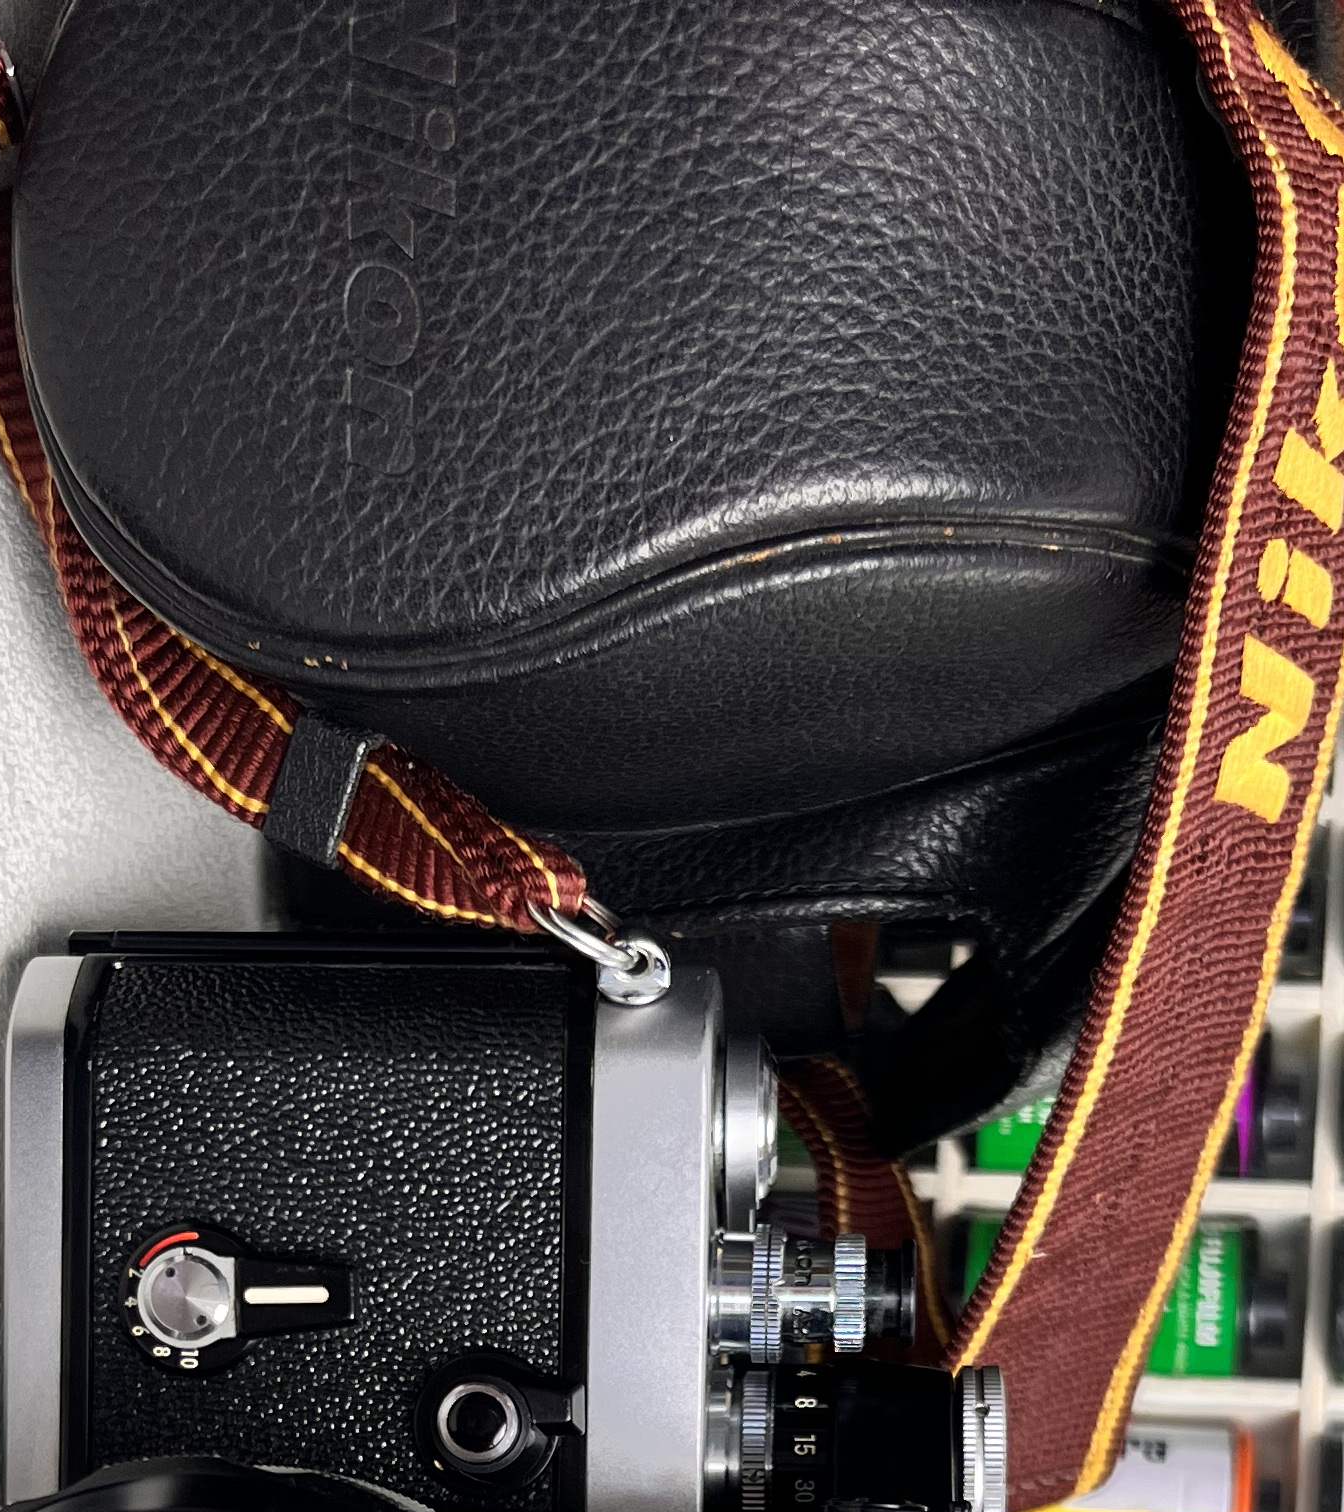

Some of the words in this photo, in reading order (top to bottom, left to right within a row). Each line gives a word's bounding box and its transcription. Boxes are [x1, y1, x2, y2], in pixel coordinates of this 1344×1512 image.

[128, 1267, 143, 1279] 2
[124, 1296, 139, 1309] 4
[132, 1325, 150, 1337] 6
[153, 1345, 171, 1357] 8
[179, 1349, 199, 1369] 10
[794, 1397, 818, 1409] 8
[793, 1433, 817, 1456] 15
[794, 1479, 815, 1503] 30
